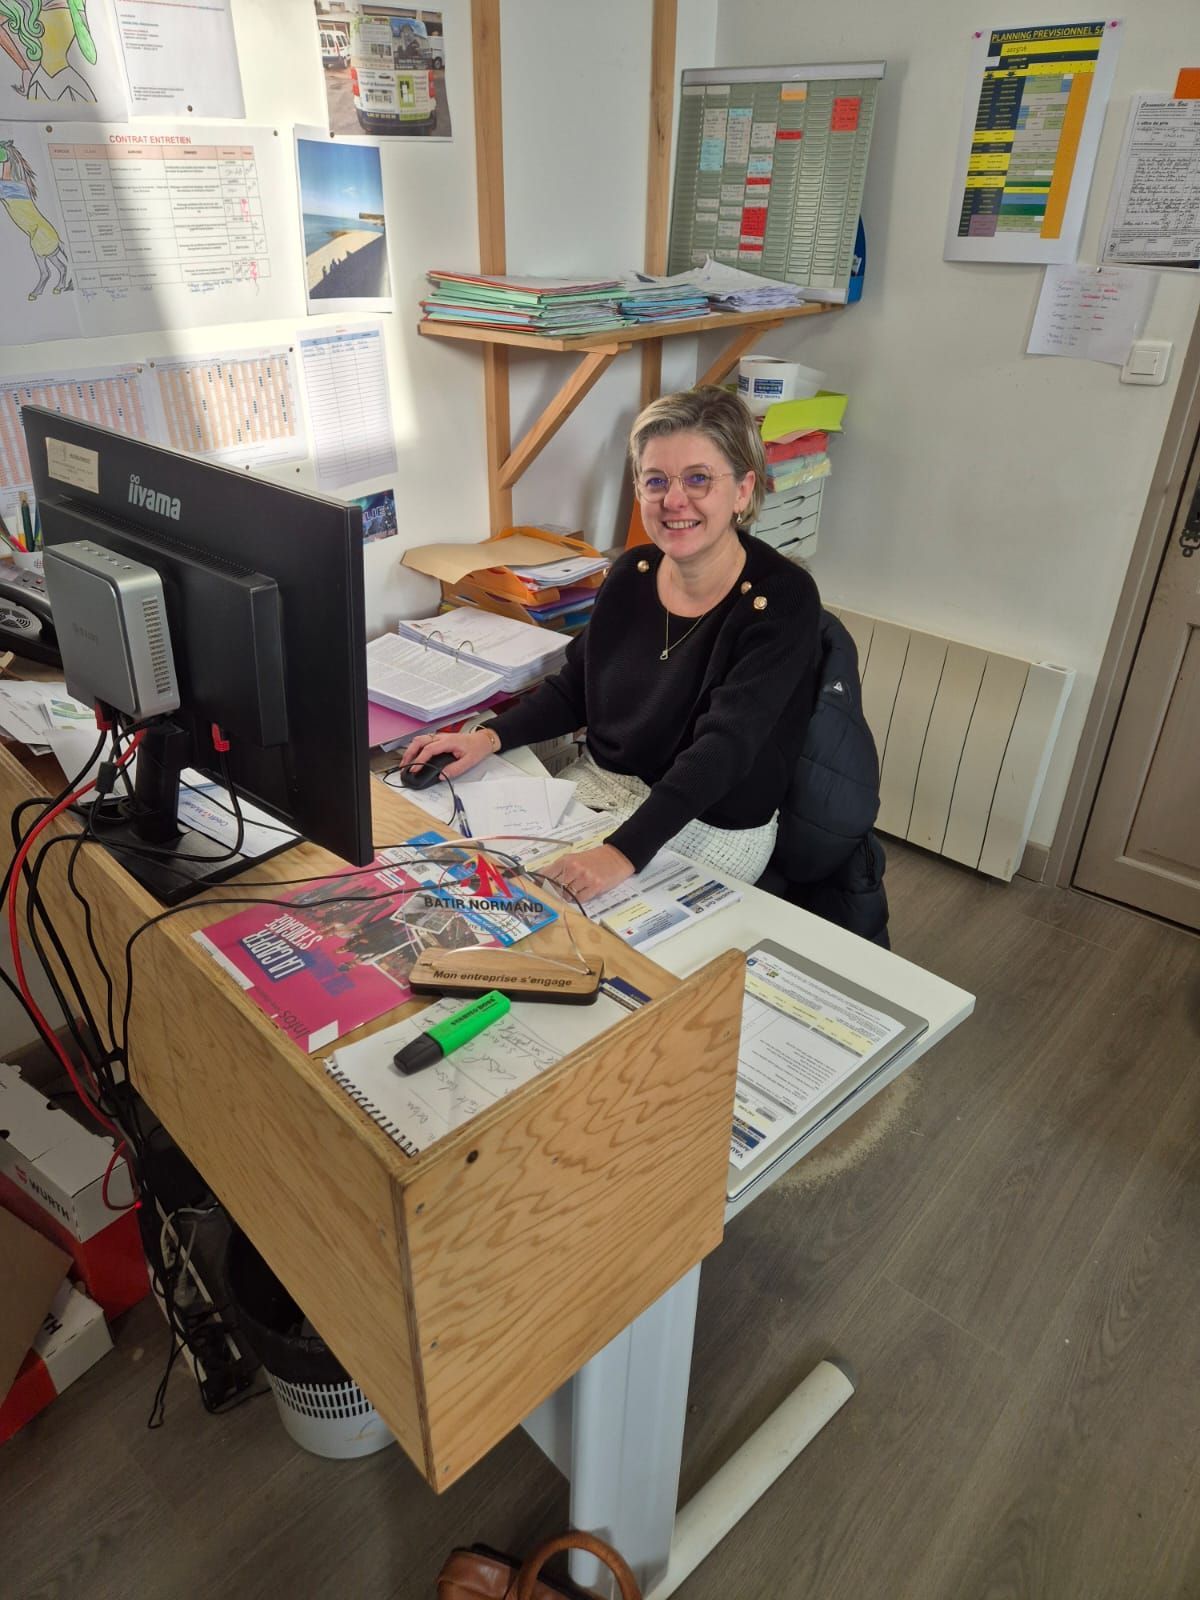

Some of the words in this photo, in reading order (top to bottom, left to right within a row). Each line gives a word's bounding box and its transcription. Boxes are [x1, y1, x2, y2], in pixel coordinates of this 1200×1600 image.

[991, 30, 1032, 42] PLANNING
[1033, 27, 1092, 40] PREVISIONNEL
[109, 136, 148, 144] CONTRAT
[150, 136, 192, 144] ENTRETIEN
[128, 474, 181, 521] iiyama
[424, 897, 465, 910] BATIR
[469, 900, 544, 913] NORMAND
[433, 970, 457, 979] Mon
[460, 972, 517, 983] entreprise
[520, 975, 572, 987] s'engage
